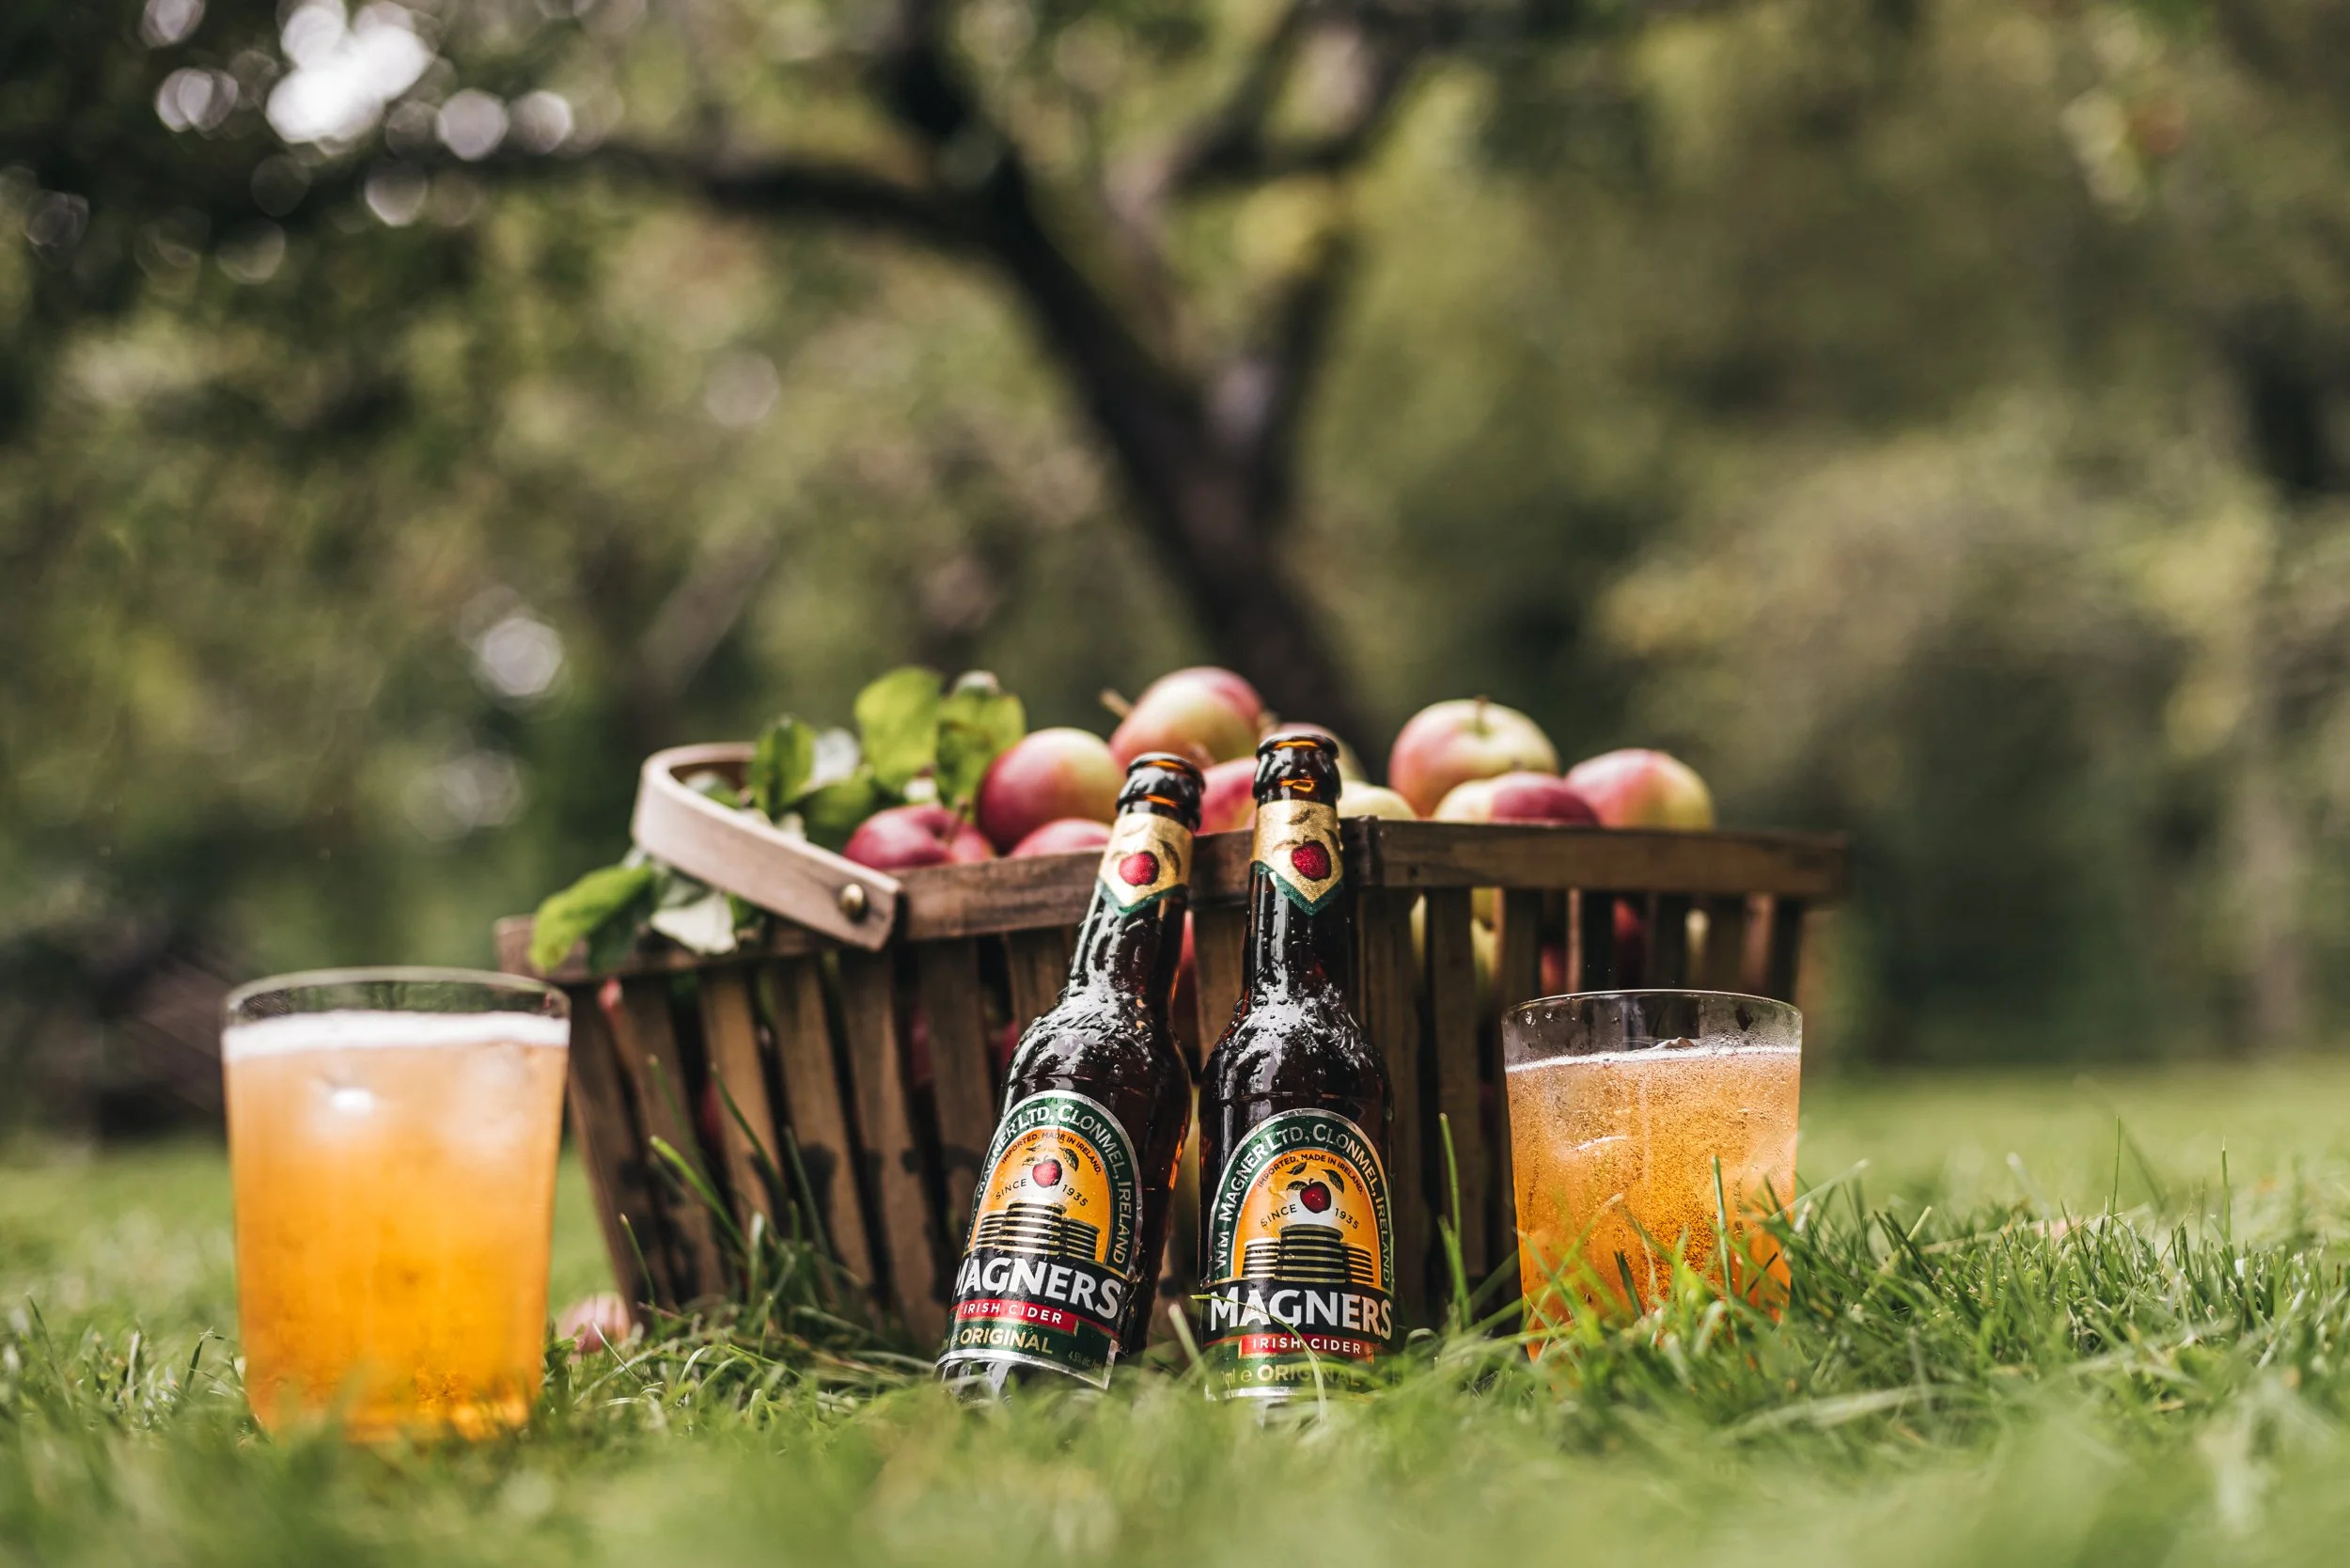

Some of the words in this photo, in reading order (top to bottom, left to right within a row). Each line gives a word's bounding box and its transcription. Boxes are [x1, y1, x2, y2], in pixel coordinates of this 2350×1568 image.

[1042, 1132, 1065, 1142] MADE
[1066, 1136, 1076, 1145] IN
[1301, 1153, 1325, 1162] MADE
[1328, 1157, 1336, 1166] IN
[1312, 1123, 1380, 1197] CLONMEL,
[995, 1178, 1026, 1200] SINCE
[1058, 1104, 1126, 1180] CLONMEL,
[1113, 1181, 1132, 1264] IRELAND
[1218, 1142, 1267, 1223] MAGNER
[1062, 1184, 1089, 1207] 1935
[1261, 1203, 1297, 1227] SINCE
[1335, 1208, 1359, 1230] 1935
[1214, 1231, 1230, 1270] WM
[1375, 1196, 1390, 1282] IRELAND
[956, 1257, 1121, 1319] MAGNERS
[964, 1302, 1000, 1315] IRISH
[1009, 1304, 1062, 1325] CIDER
[1210, 1286, 1392, 1341] MAGNERS
[960, 1327, 1053, 1355] ORIGINAL
[1253, 1337, 1302, 1349] IRISH
[1310, 1338, 1361, 1355] CIDER
[1257, 1364, 1360, 1387] ORIGNAL
